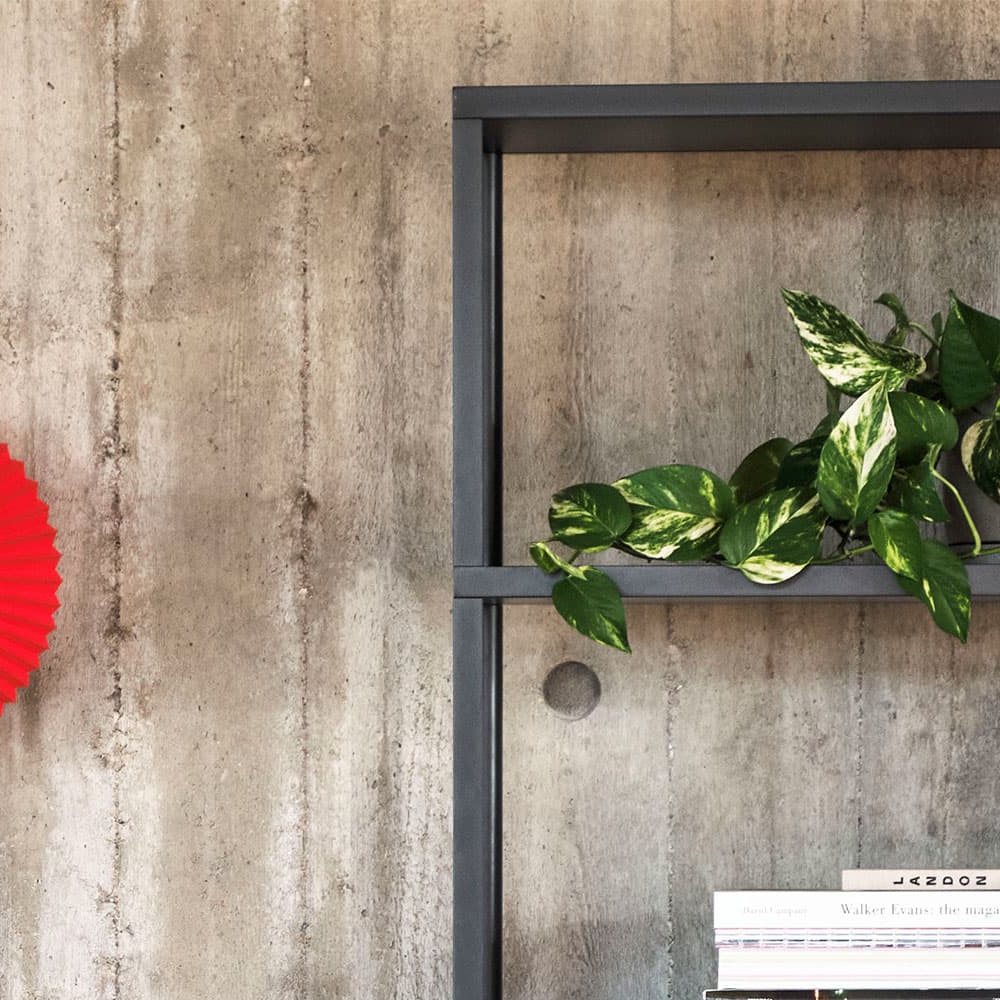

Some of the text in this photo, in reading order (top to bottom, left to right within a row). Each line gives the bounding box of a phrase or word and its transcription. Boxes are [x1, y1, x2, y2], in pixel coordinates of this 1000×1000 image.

[893, 875, 987, 886] LANDON
[841, 903, 886, 915] Walker
[939, 903, 960, 915] the
